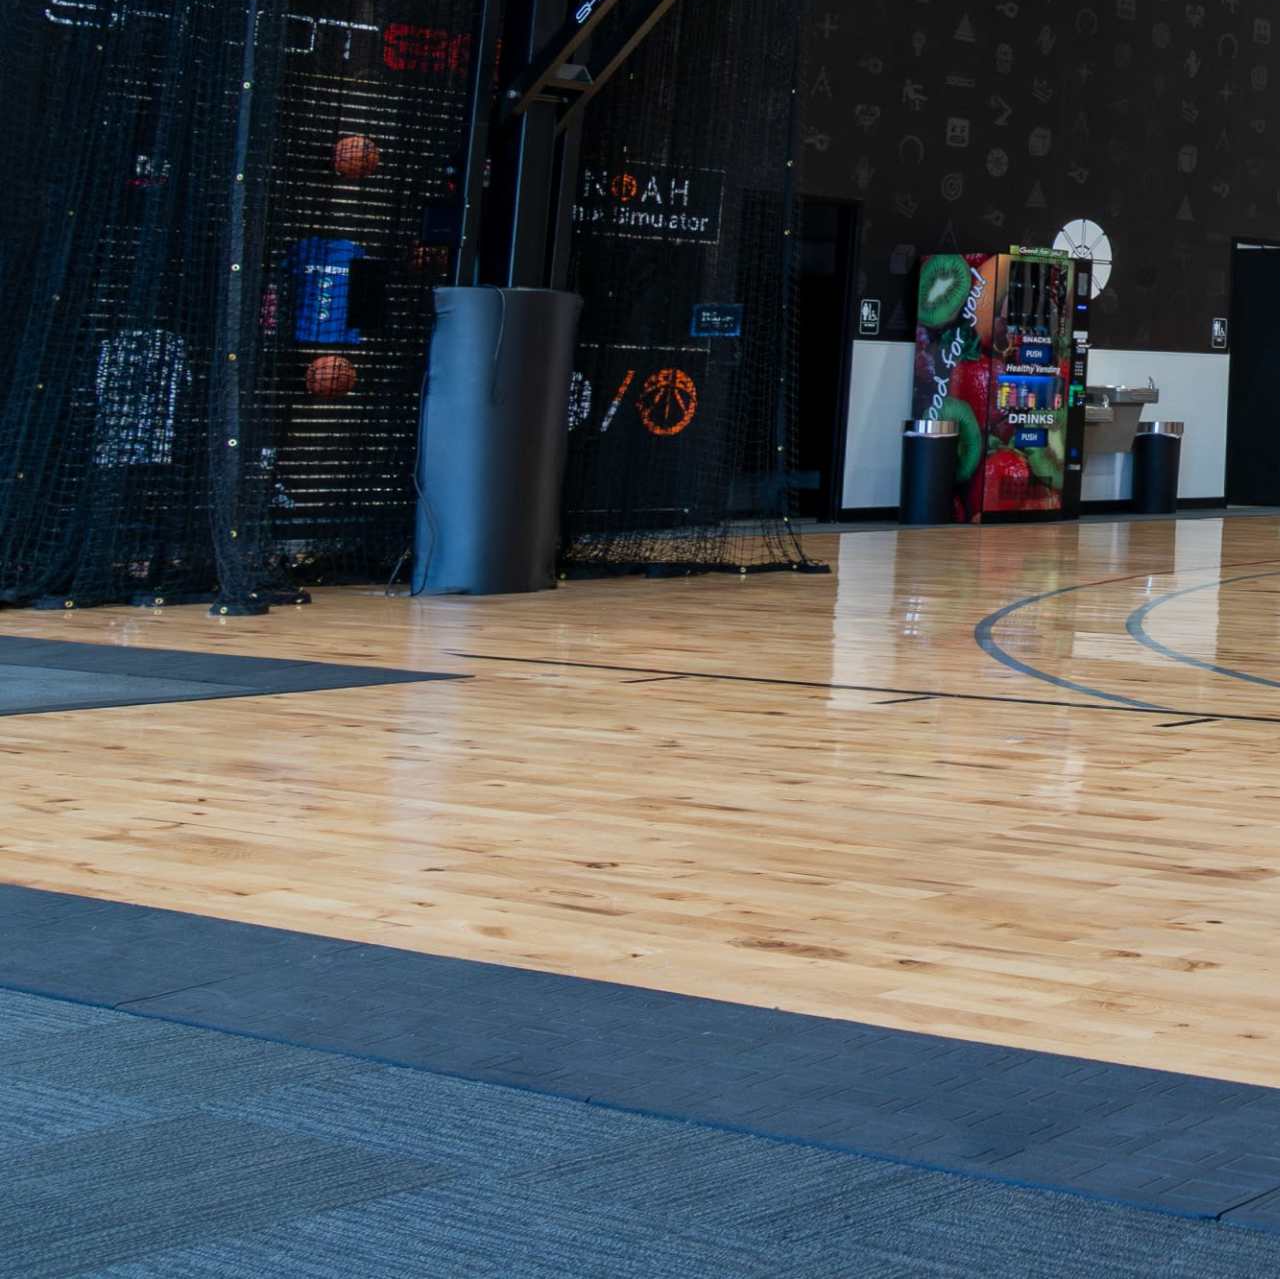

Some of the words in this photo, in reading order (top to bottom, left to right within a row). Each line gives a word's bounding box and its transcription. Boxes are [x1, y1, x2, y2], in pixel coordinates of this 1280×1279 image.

[1022, 336, 1051, 344] SNACKS
[1025, 350, 1043, 358] PUSH
[1006, 363, 1034, 375] Healthy
[1035, 365, 1061, 376] Vending
[928, 375, 950, 422] ood
[941, 327, 965, 369] for
[1008, 414, 1054, 424] DRINKS
[1020, 433, 1038, 441] PUSH
